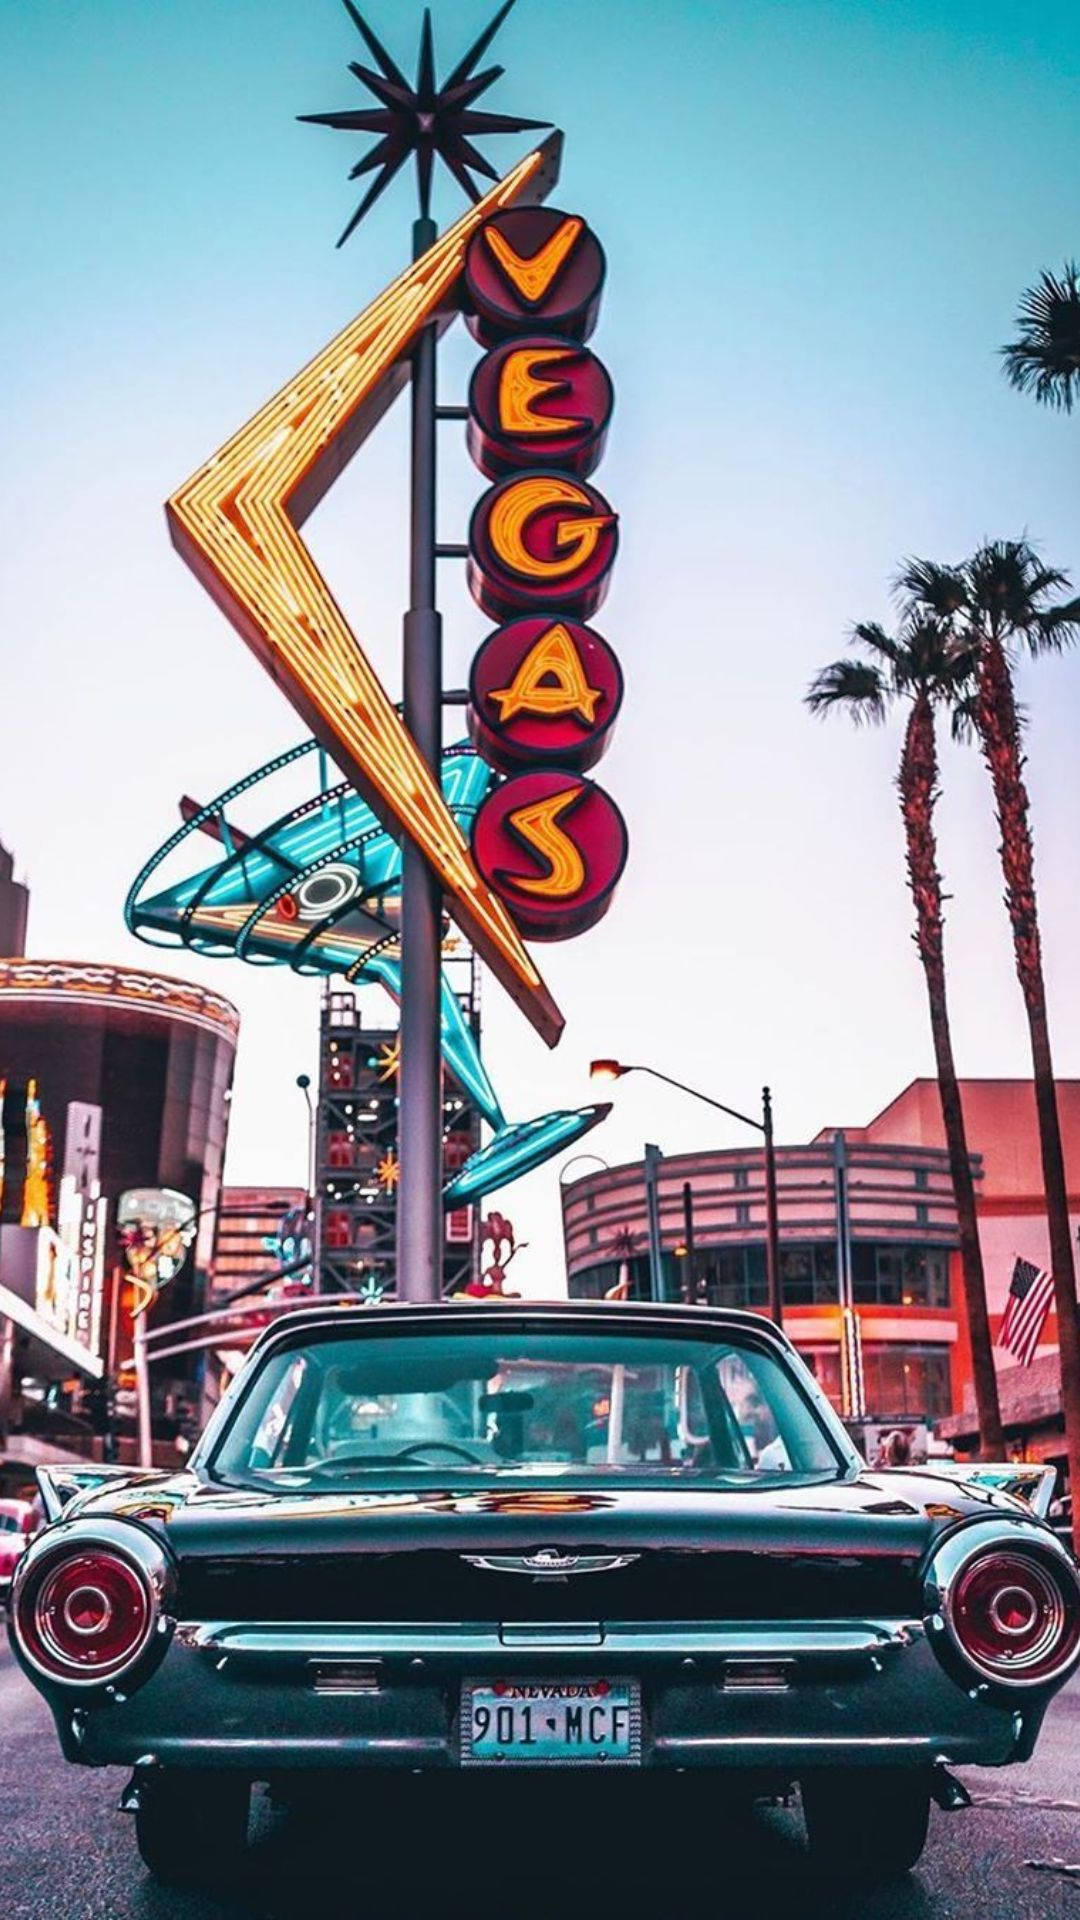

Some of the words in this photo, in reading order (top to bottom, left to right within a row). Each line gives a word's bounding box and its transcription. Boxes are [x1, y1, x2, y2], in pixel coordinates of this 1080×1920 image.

[485, 216, 617, 898] VEGAS
[77, 1203, 96, 1329] INSPIRE
[474, 1705, 537, 1745] 901
[565, 1705, 630, 1745] MCF
[508, 1685, 595, 1699] NEVADA
